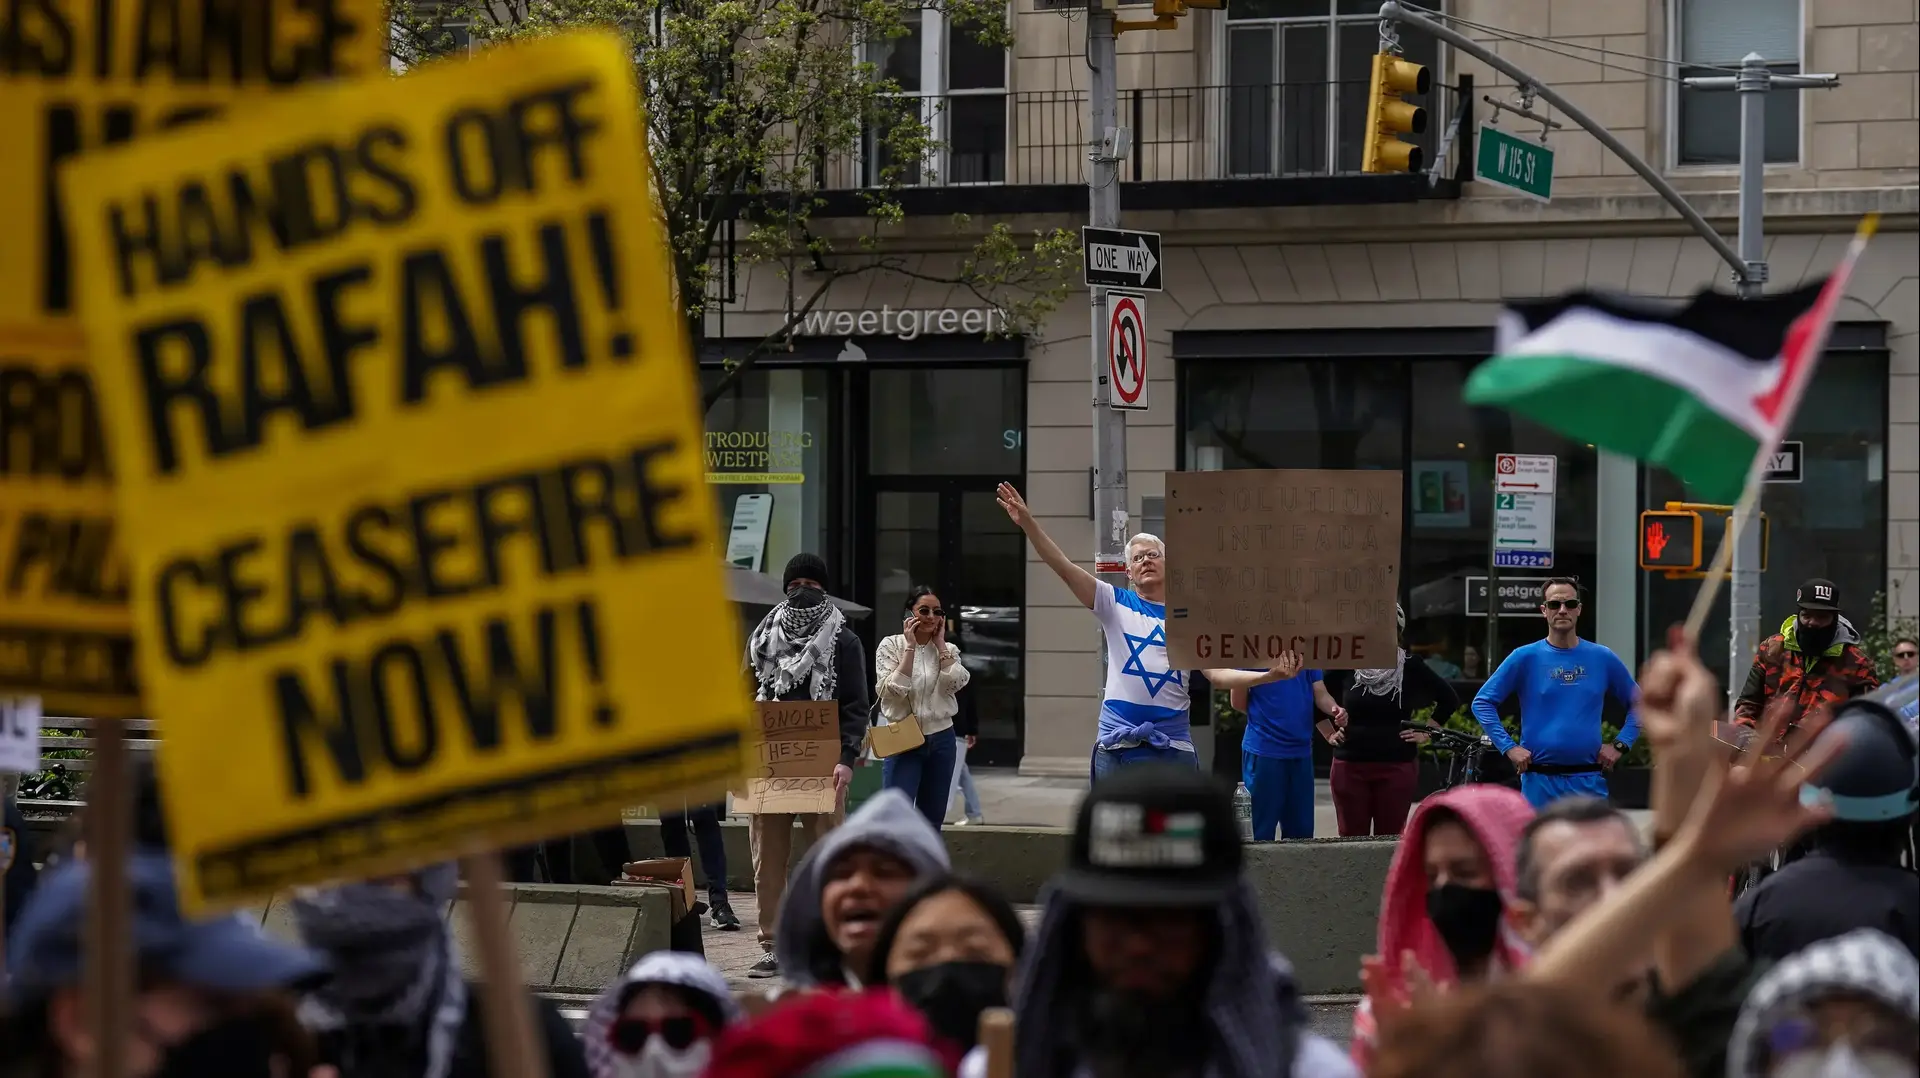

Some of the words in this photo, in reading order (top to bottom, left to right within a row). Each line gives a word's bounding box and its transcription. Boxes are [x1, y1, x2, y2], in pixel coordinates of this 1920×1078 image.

[1498, 142, 1507, 174] W
[1509, 146, 1523, 180] 115
[1525, 152, 1536, 185] St
[106, 123, 420, 299] HANDS
[442, 79, 599, 205] OFF
[1096, 246, 1118, 269] ONE
[1127, 249, 1150, 272] WAY
[131, 209, 637, 474] RAFAH!
[705, 432, 812, 448] TRODUCING
[704, 451, 800, 468] WEETPASS
[1765, 455, 1786, 469] AY
[1217, 523, 1378, 551] INTIFADA
[155, 440, 698, 668] CEASEFIRE
[1496, 554, 1537, 566] 111922
[1233, 600, 1319, 625] CALL
[1336, 600, 1389, 625] FOR
[1196, 633, 1366, 660] GENOCIDE
[273, 600, 619, 796] NOW!
[754, 741, 820, 762] THESE
